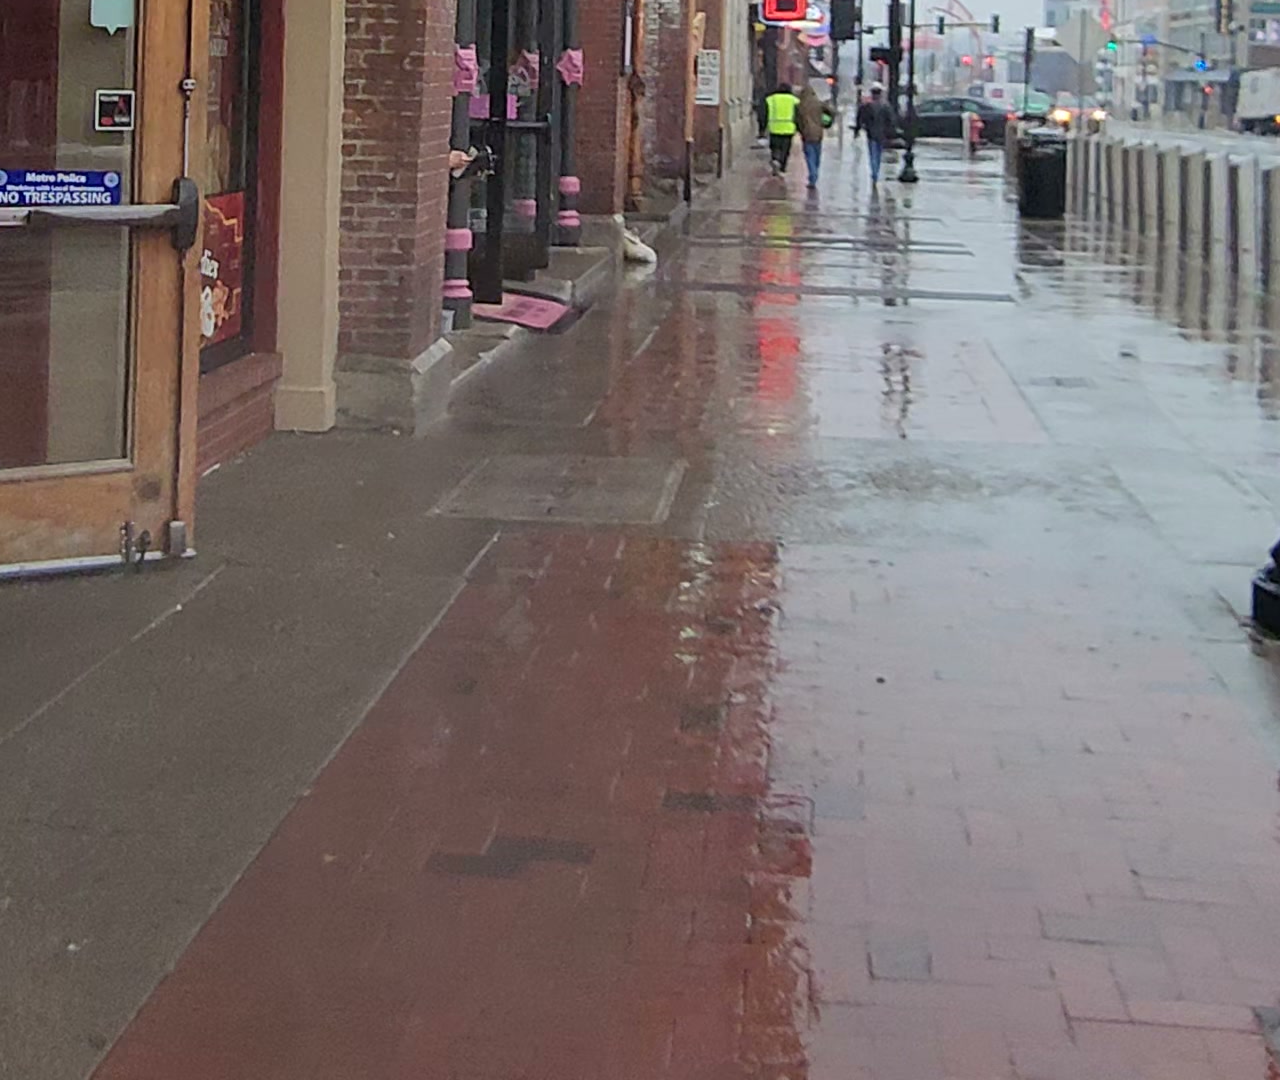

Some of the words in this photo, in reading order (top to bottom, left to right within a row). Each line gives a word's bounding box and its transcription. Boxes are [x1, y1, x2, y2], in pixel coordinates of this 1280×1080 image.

[25, 172, 56, 183] Metro
[57, 172, 87, 184] Police
[23, 191, 112, 204] TRESPASSING
